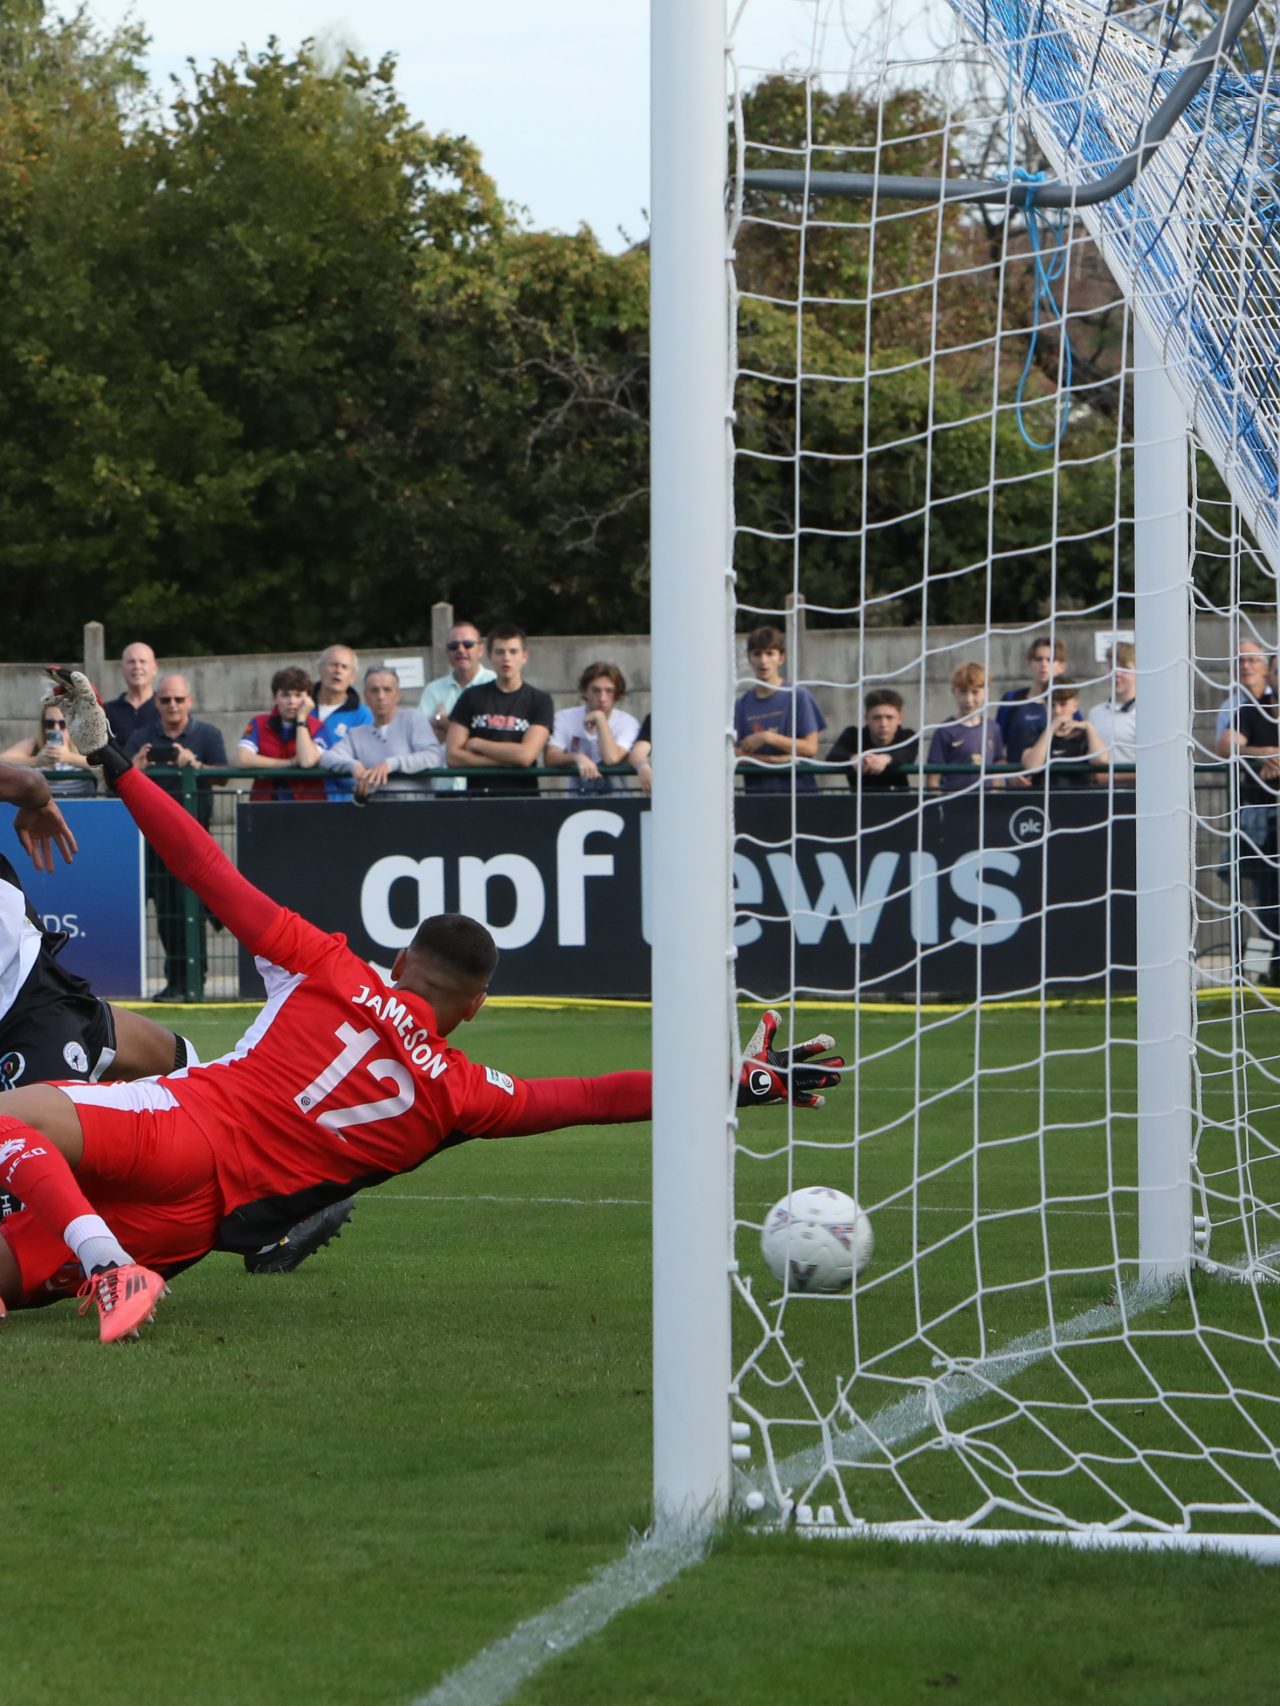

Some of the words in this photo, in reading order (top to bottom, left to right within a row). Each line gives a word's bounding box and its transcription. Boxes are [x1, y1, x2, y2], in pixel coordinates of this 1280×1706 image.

[1019, 818, 1042, 838] plc
[352, 984, 448, 1079] JAMESON
[293, 1020, 415, 1143] 12
